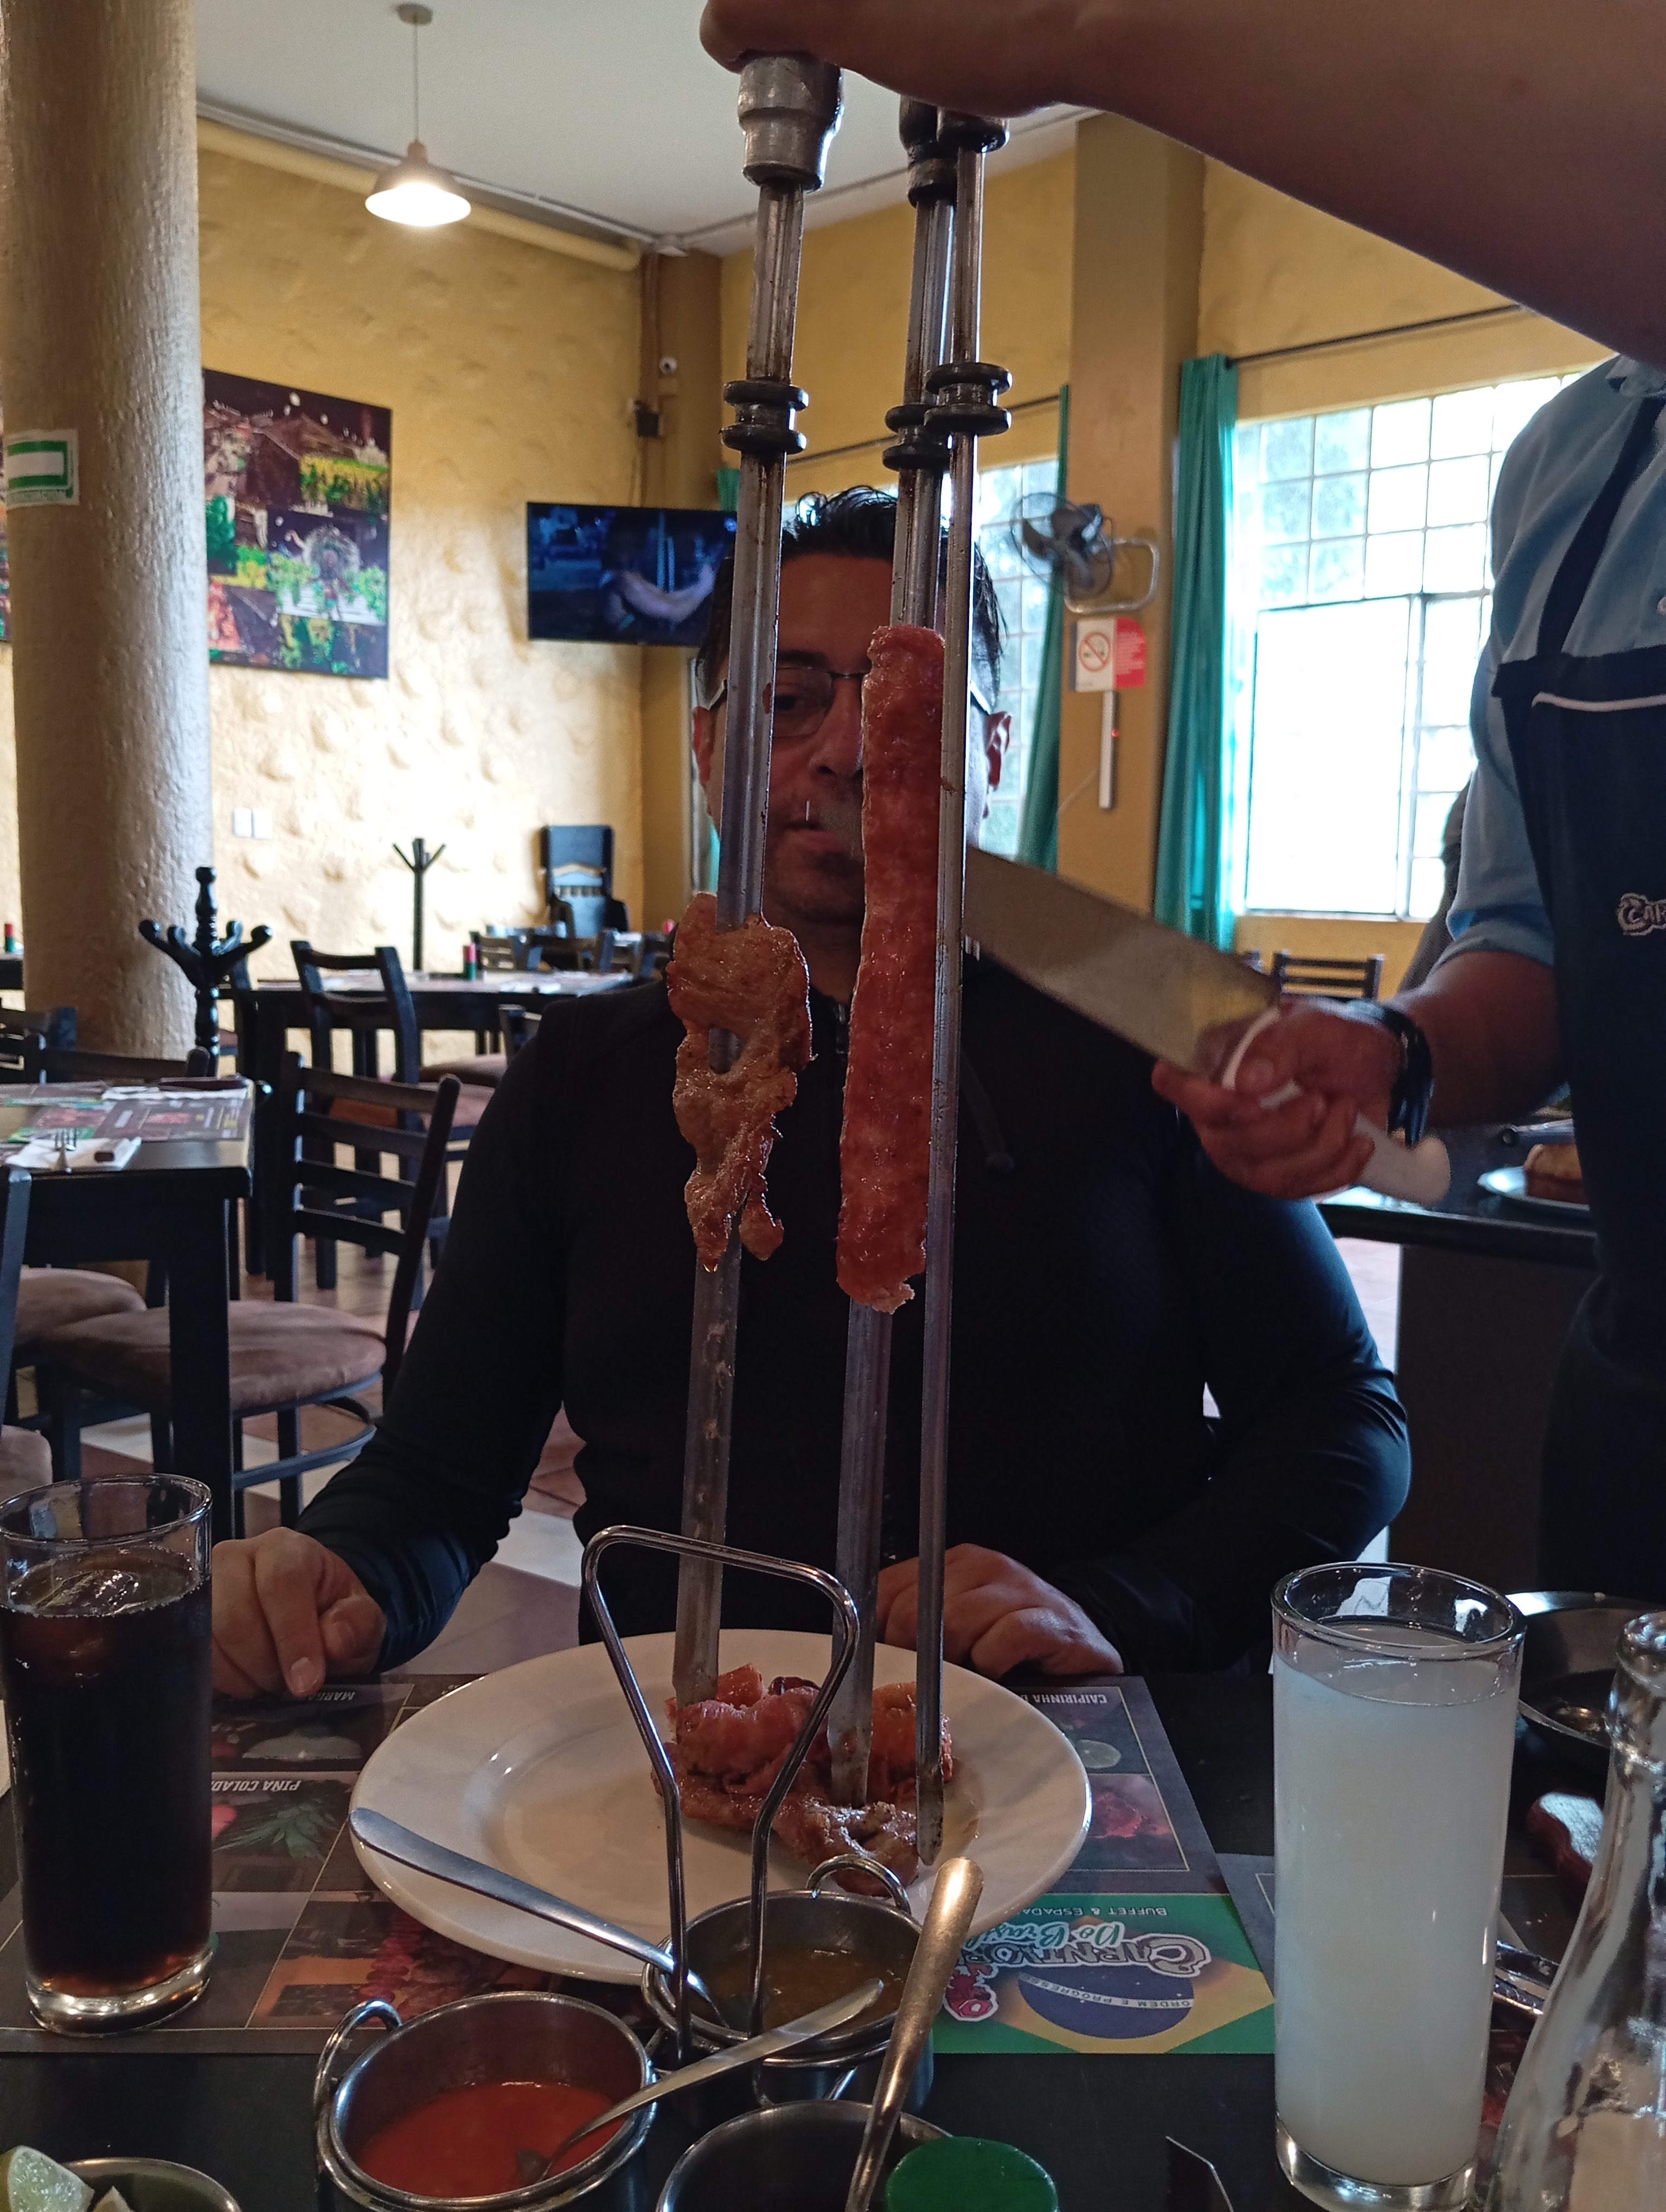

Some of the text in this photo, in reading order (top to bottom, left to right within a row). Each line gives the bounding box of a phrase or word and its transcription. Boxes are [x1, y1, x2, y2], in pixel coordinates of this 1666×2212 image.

[1032, 1694, 1107, 1704] CAIPIRINHA
[211, 1780, 260, 1792] COLAD
[1017, 1906, 1167, 1916] BUFFET & ESPADA
[1077, 1924, 1122, 1948] Do
